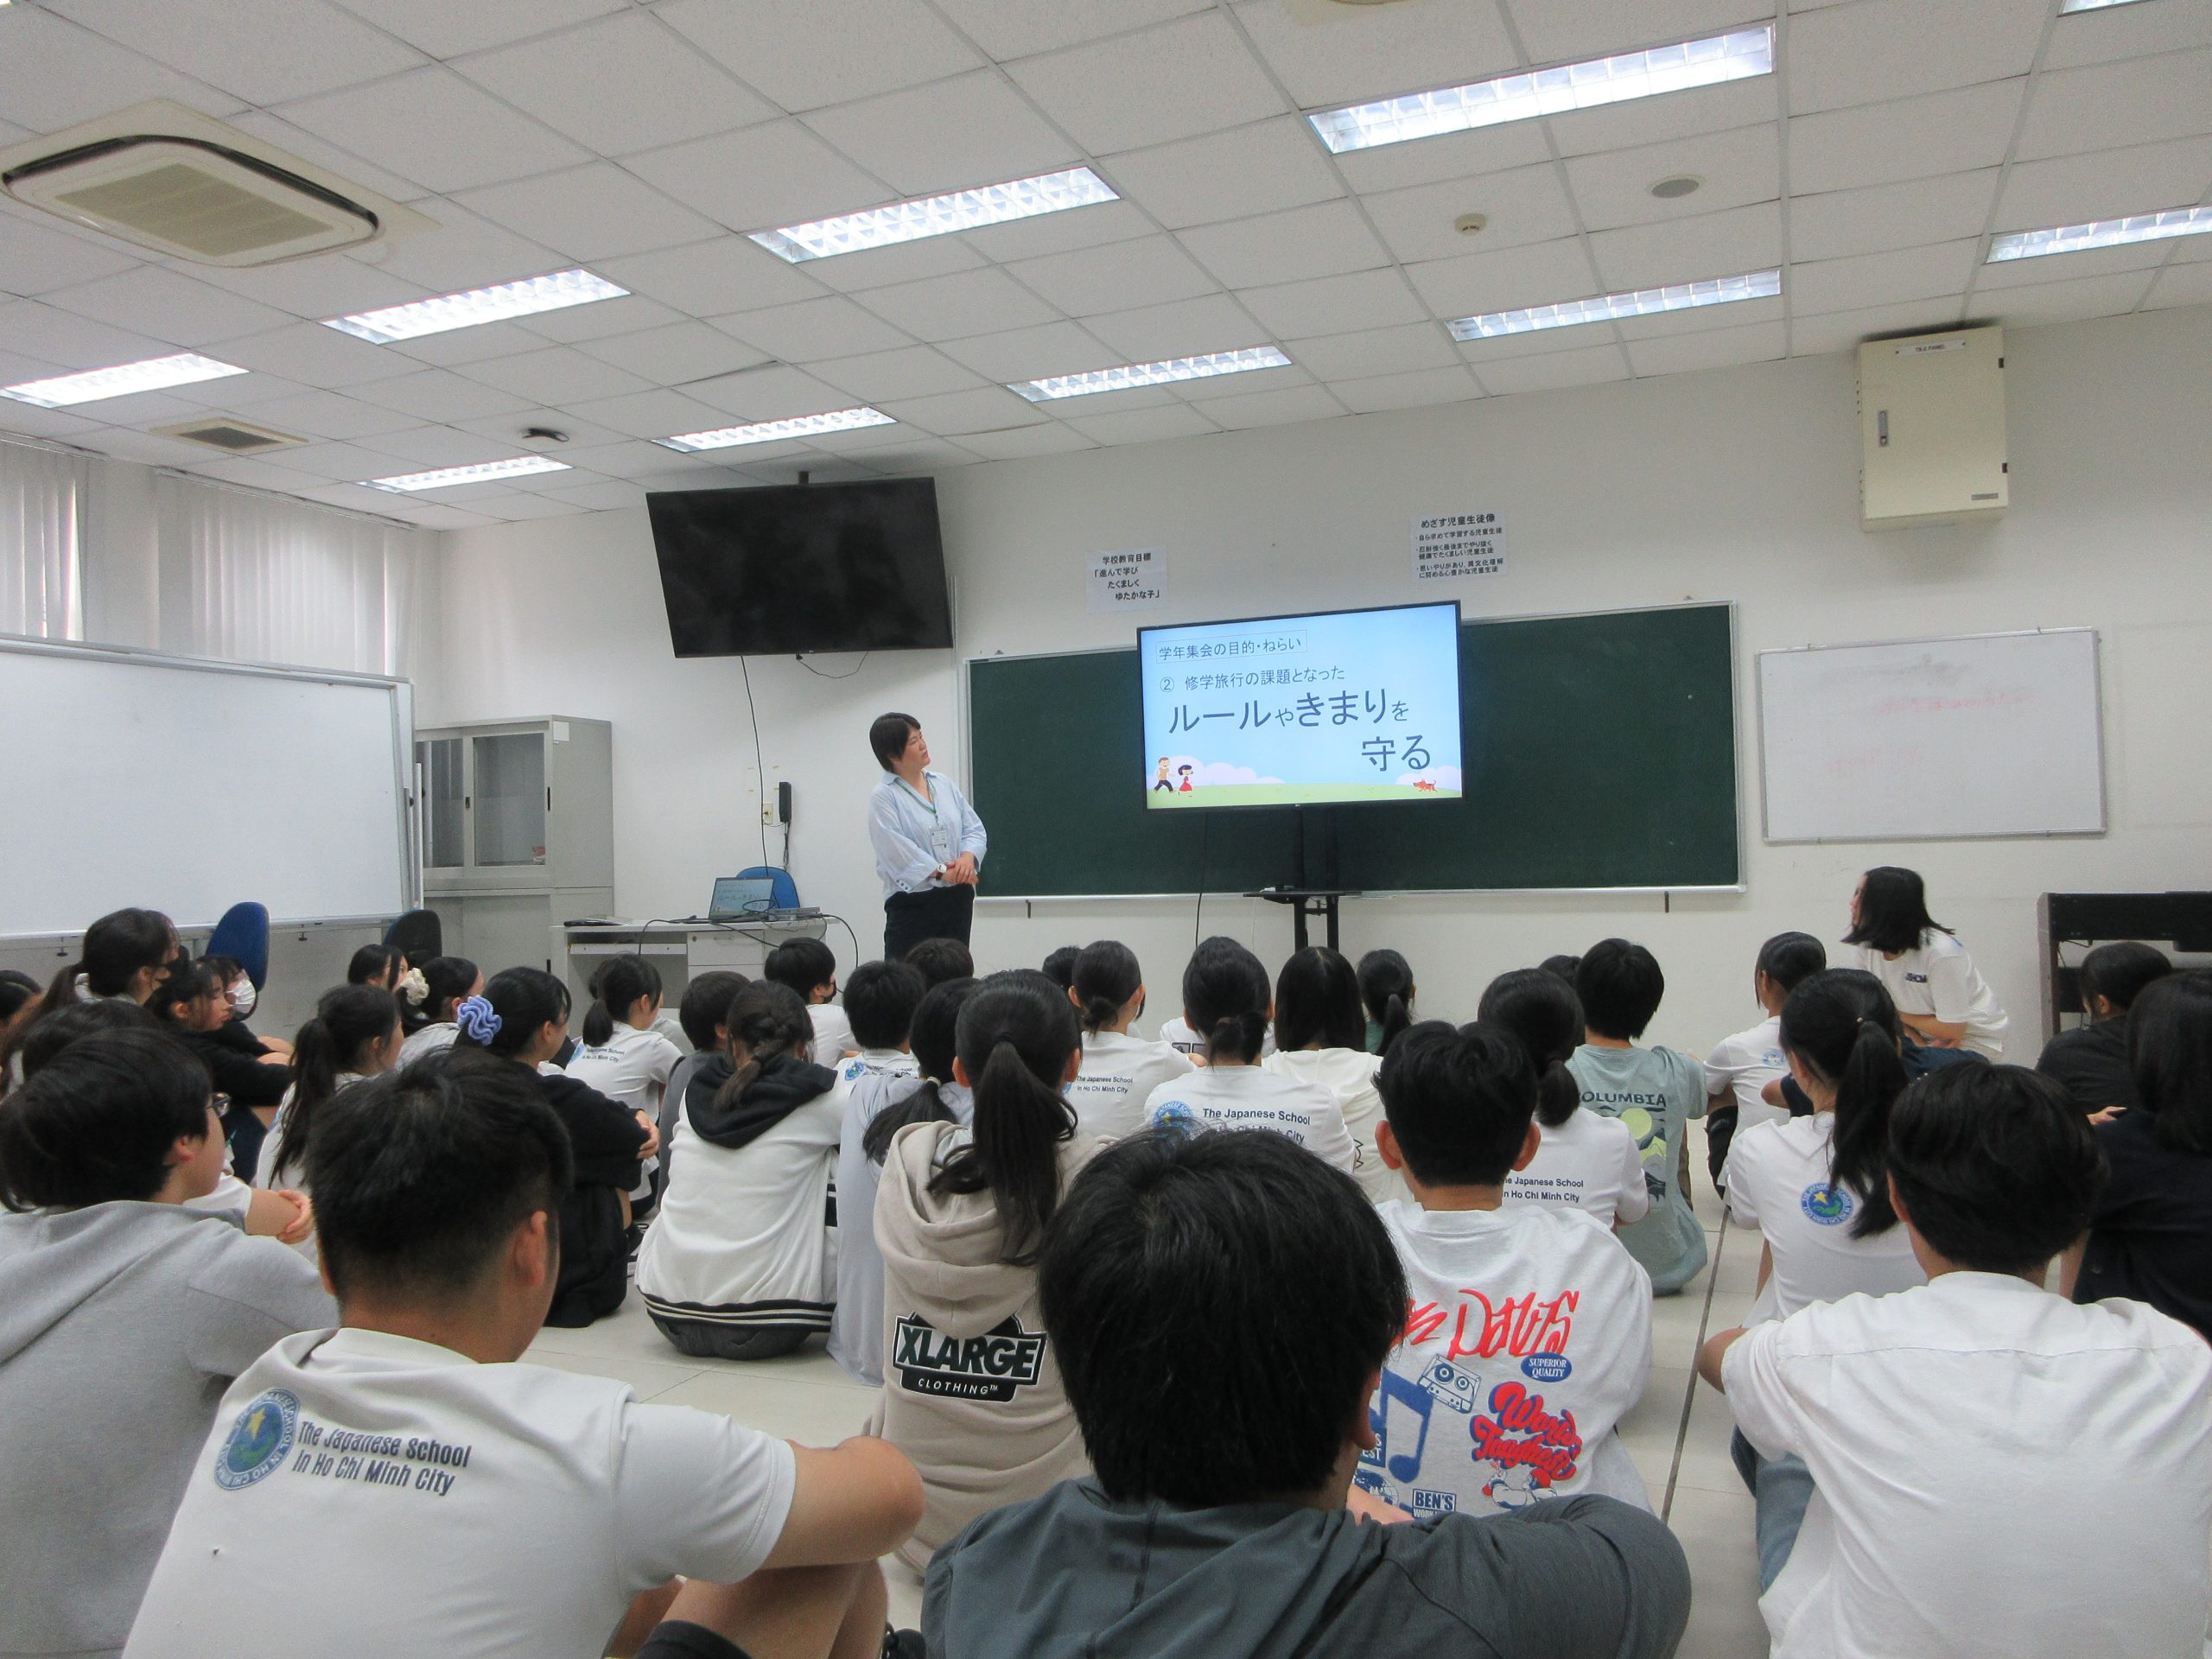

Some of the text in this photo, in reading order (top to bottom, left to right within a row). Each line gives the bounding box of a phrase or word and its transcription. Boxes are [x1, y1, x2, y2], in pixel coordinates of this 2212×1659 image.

[1421, 513, 1495, 528] めざす児童生徒像
[1103, 553, 1151, 565] 学校教育目標
[1108, 579, 1140, 589] たくましく
[1116, 589, 1160, 601] ゆたかな子」
[1159, 638, 1301, 660] 学年集会の目的・ねらい
[1185, 665, 1345, 690] 修学旅行の課題となった
[1169, 689, 1409, 734] ルールやきまりを
[1361, 734, 1431, 772] 守る
[1578, 1090, 1667, 1108] OLUMBIA
[1203, 1108, 1311, 1125] The Japanese School
[1286, 1129, 1306, 1143] City
[1514, 1177, 1554, 1187] Japanese
[1555, 1178, 1584, 1188] School
[1511, 1190, 1522, 1198] Ho
[1524, 1191, 1539, 1199] Chi
[1541, 1192, 1561, 1200] Minh
[1563, 1192, 1580, 1204] City
[896, 1325, 1039, 1379] XLARGE
[1528, 1357, 1567, 1368] SUPERIOR
[1531, 1367, 1565, 1379] QUALITY
[297, 1421, 473, 1468] The Japanese School
[311, 1452, 334, 1476] Ho
[334, 1455, 365, 1479] Chi
[365, 1459, 412, 1487] Minh
[415, 1467, 456, 1497] City
[1414, 1491, 1453, 1510] BEN'S
